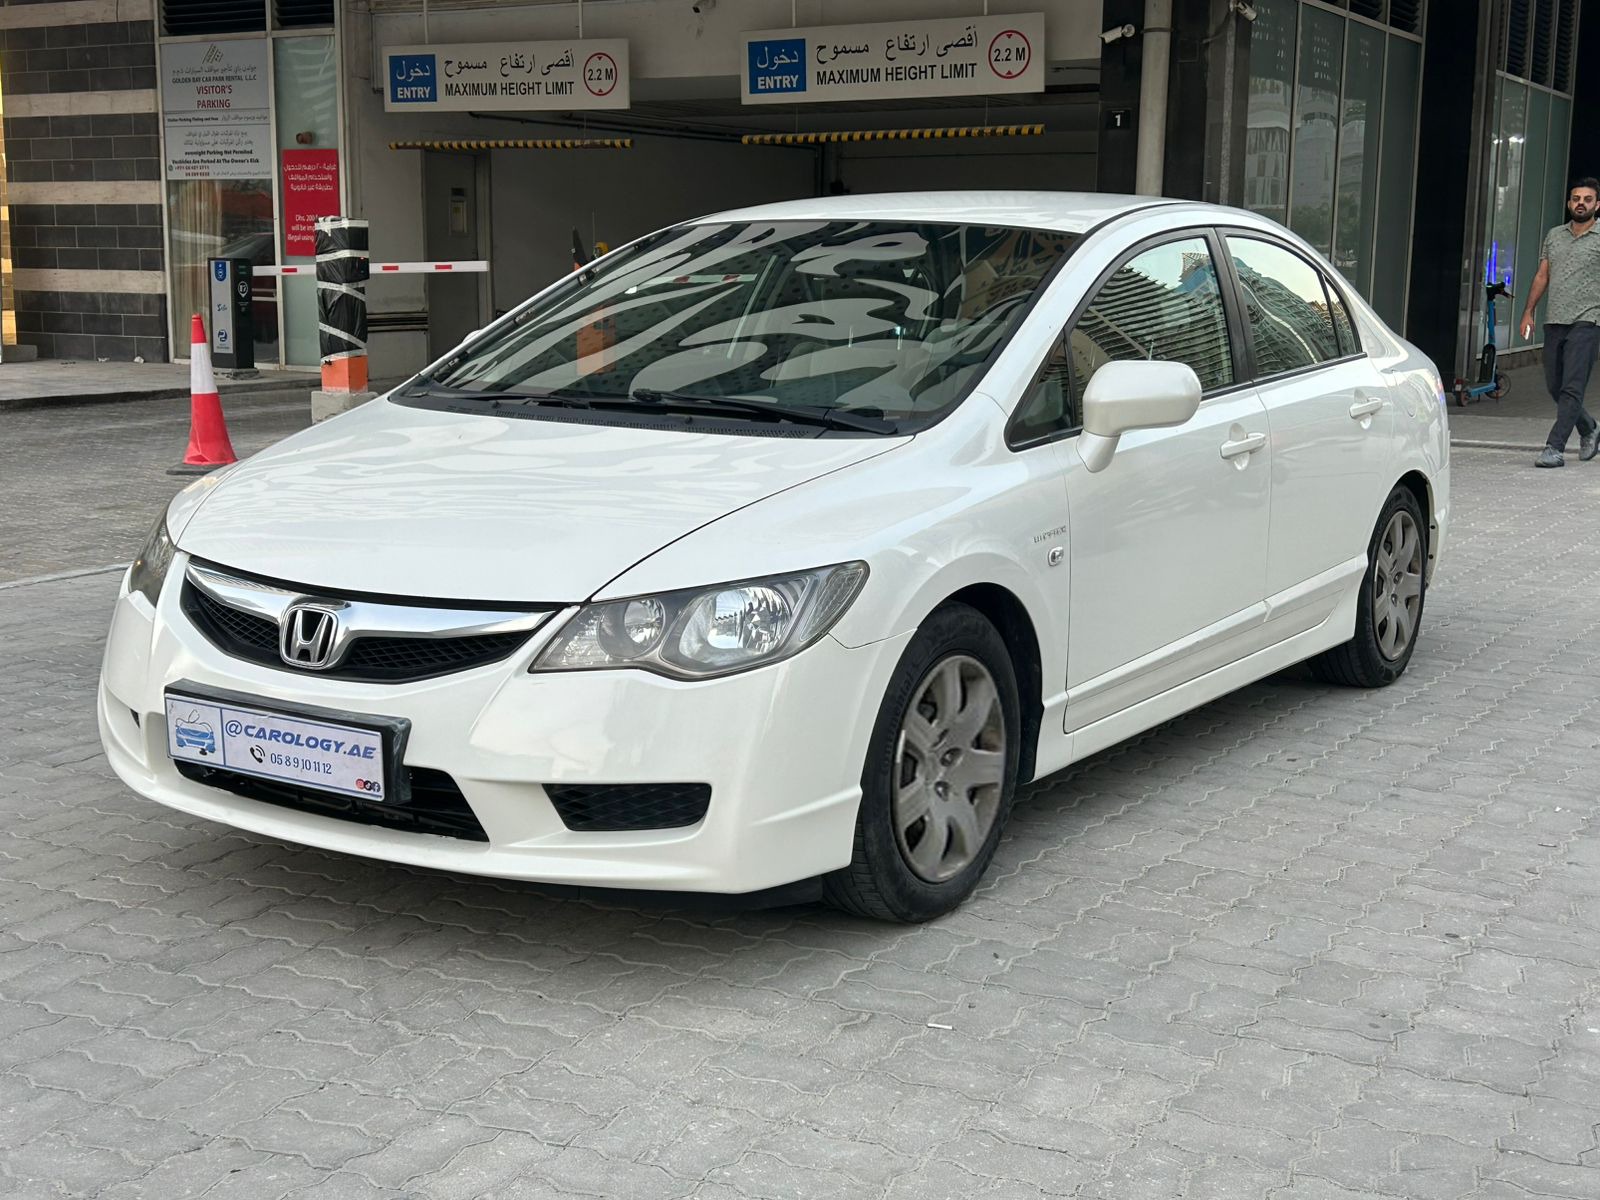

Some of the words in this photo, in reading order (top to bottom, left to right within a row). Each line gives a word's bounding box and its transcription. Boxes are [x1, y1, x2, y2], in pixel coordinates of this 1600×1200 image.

[885, 34, 930, 60] ارتفاع
[936, 24, 978, 58] أقصى
[541, 48, 574, 76] أقصى
[757, 46, 799, 70] دخول
[816, 42, 870, 64] مسموح
[994, 48, 1012, 62] 2.2
[1015, 46, 1026, 61] M
[396, 60, 430, 82] دخول
[444, 58, 488, 78] مسموح
[499, 53, 536, 76] ارتفاع
[588, 68, 602, 81] 2.2
[604, 68, 614, 80] M
[816, 68, 880, 86] MAXIMUM
[885, 65, 936, 82] HEIGHT
[940, 63, 978, 80] LIMIT
[196, 84, 232, 95] VISITOR'S
[397, 86, 431, 98] ENTRY
[445, 82, 497, 97] MAXIMUM
[500, 82, 542, 96] HEIGHT
[545, 81, 574, 96] LIMIT
[757, 75, 799, 89] ENTRY
[197, 99, 230, 108] PARKING
[1115, 114, 1120, 127] 1
[225, 720, 376, 760] @CAROLOGY.AE
